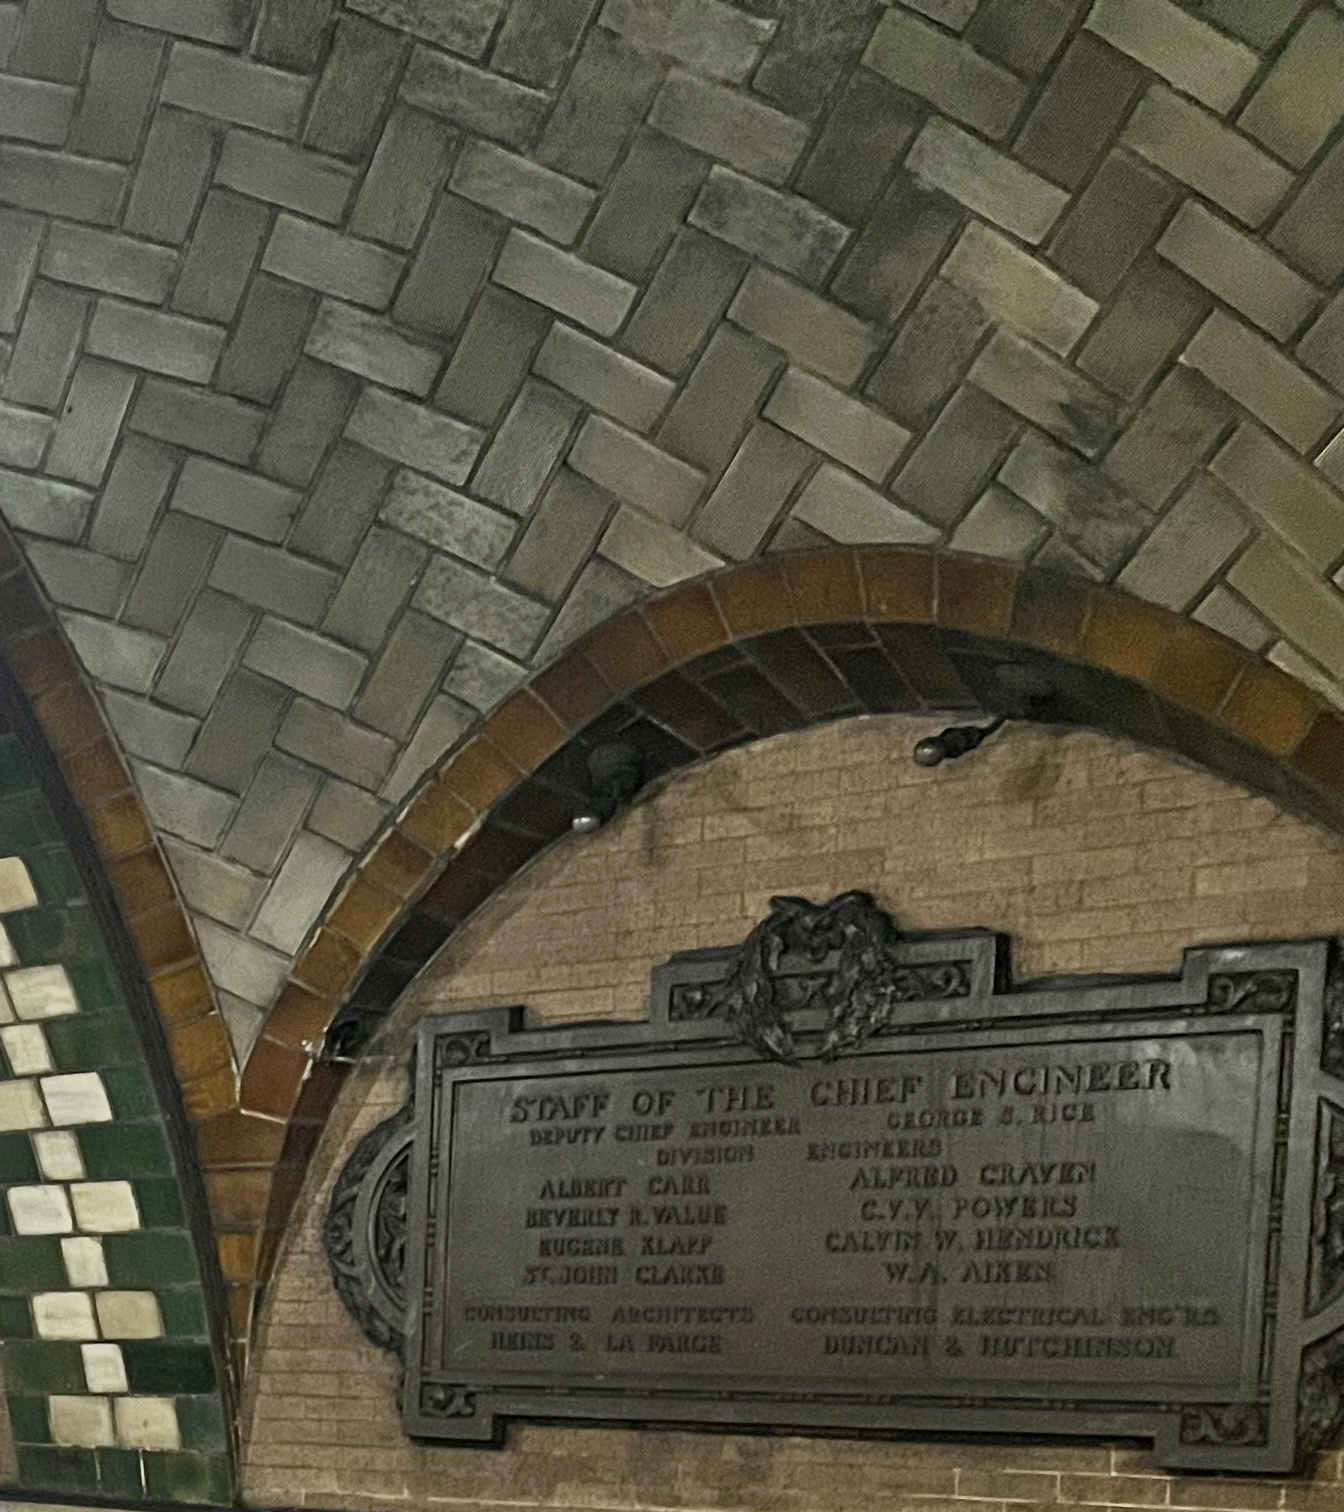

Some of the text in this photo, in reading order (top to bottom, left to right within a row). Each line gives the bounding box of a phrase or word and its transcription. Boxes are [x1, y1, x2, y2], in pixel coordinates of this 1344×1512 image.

[509, 1058, 1172, 1123] STAFF OF THE CHIEF ENGINEER
[886, 1108, 983, 1130] GEORGE
[1030, 1102, 1096, 1125] RICE
[529, 1116, 802, 1146] DEPUTY CHIEF ENGINEER
[656, 1137, 943, 1166] DIVISION ENGINEERS
[539, 1174, 712, 1200] ALBERT CARR
[850, 1160, 1096, 1190] ALFRED CRAVEN
[525, 1207, 620, 1229] BEVERLY
[952, 1194, 1079, 1220] POWERS
[640, 1234, 712, 1256] KLAPP
[824, 1230, 923, 1253] CALVIN
[974, 1226, 1122, 1252] HENDRICK
[960, 1259, 1054, 1284] AIKEN
[463, 1304, 755, 1324] CONSULTING ARCHITECTS
[790, 1306, 939, 1326] CONSULTING
[950, 1305, 1106, 1327] ELECTRICAL
[491, 1331, 555, 1351] HEINS
[569, 1331, 587, 1352] &
[606, 1333, 635, 1353] LA
[823, 1333, 931, 1357] DUNCAN
[944, 1334, 963, 1357] &
